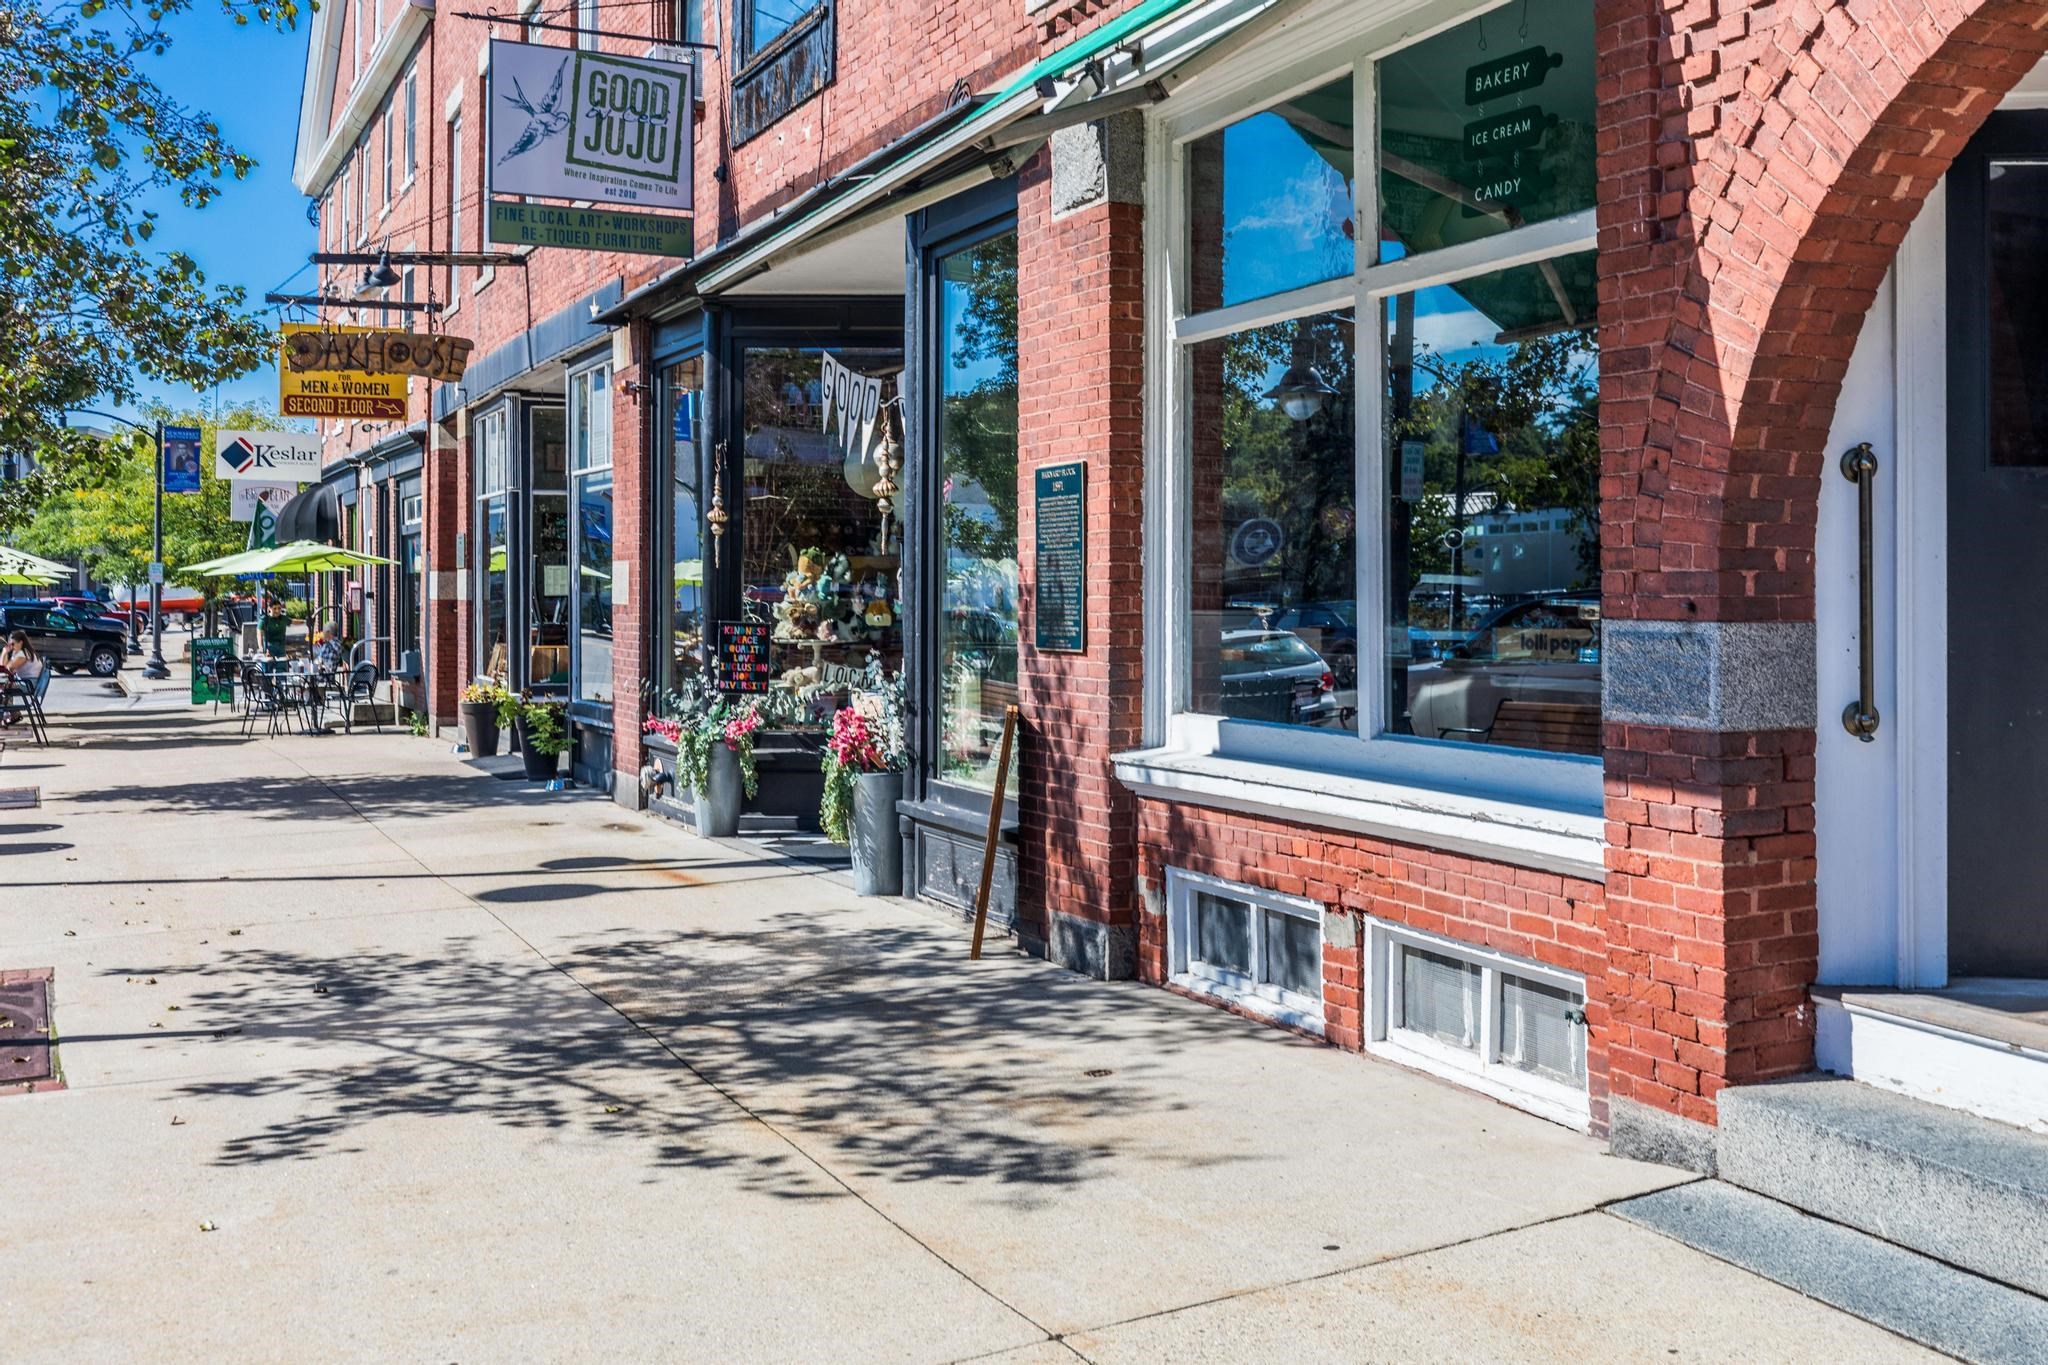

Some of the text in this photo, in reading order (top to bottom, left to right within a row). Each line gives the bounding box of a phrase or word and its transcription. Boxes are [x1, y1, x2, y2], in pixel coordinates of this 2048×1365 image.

[1475, 62, 1530, 92] BAKERY
[588, 70, 670, 120] GOOD
[584, 113, 668, 164] JUJU
[1472, 118, 1531, 147] ICE CREAM
[564, 167, 678, 196] Where Inspiration Comes To Life
[1474, 177, 1521, 202] CANDY
[604, 187, 637, 200] est 2010
[496, 207, 687, 236] FINE LOCAL ART WORKSHOPS
[596, 233, 663, 251] FURNITURE
[286, 332, 469, 376] OAKHOUSE
[338, 374, 352, 382] FOR
[301, 380, 390, 396] MEN & WOMEN
[823, 361, 877, 422] GOOD
[289, 397, 375, 415] SECOND FLOOR
[254, 445, 317, 468] Keslar
[724, 626, 767, 636] KINDNESS
[723, 644, 766, 654] EQUALITY
[732, 636, 758, 645] PEACE
[733, 653, 756, 662] LOVE
[720, 662, 768, 672] INCLUSION
[732, 671, 755, 680] HOPE
[720, 680, 767, 690] DIVERSITY
